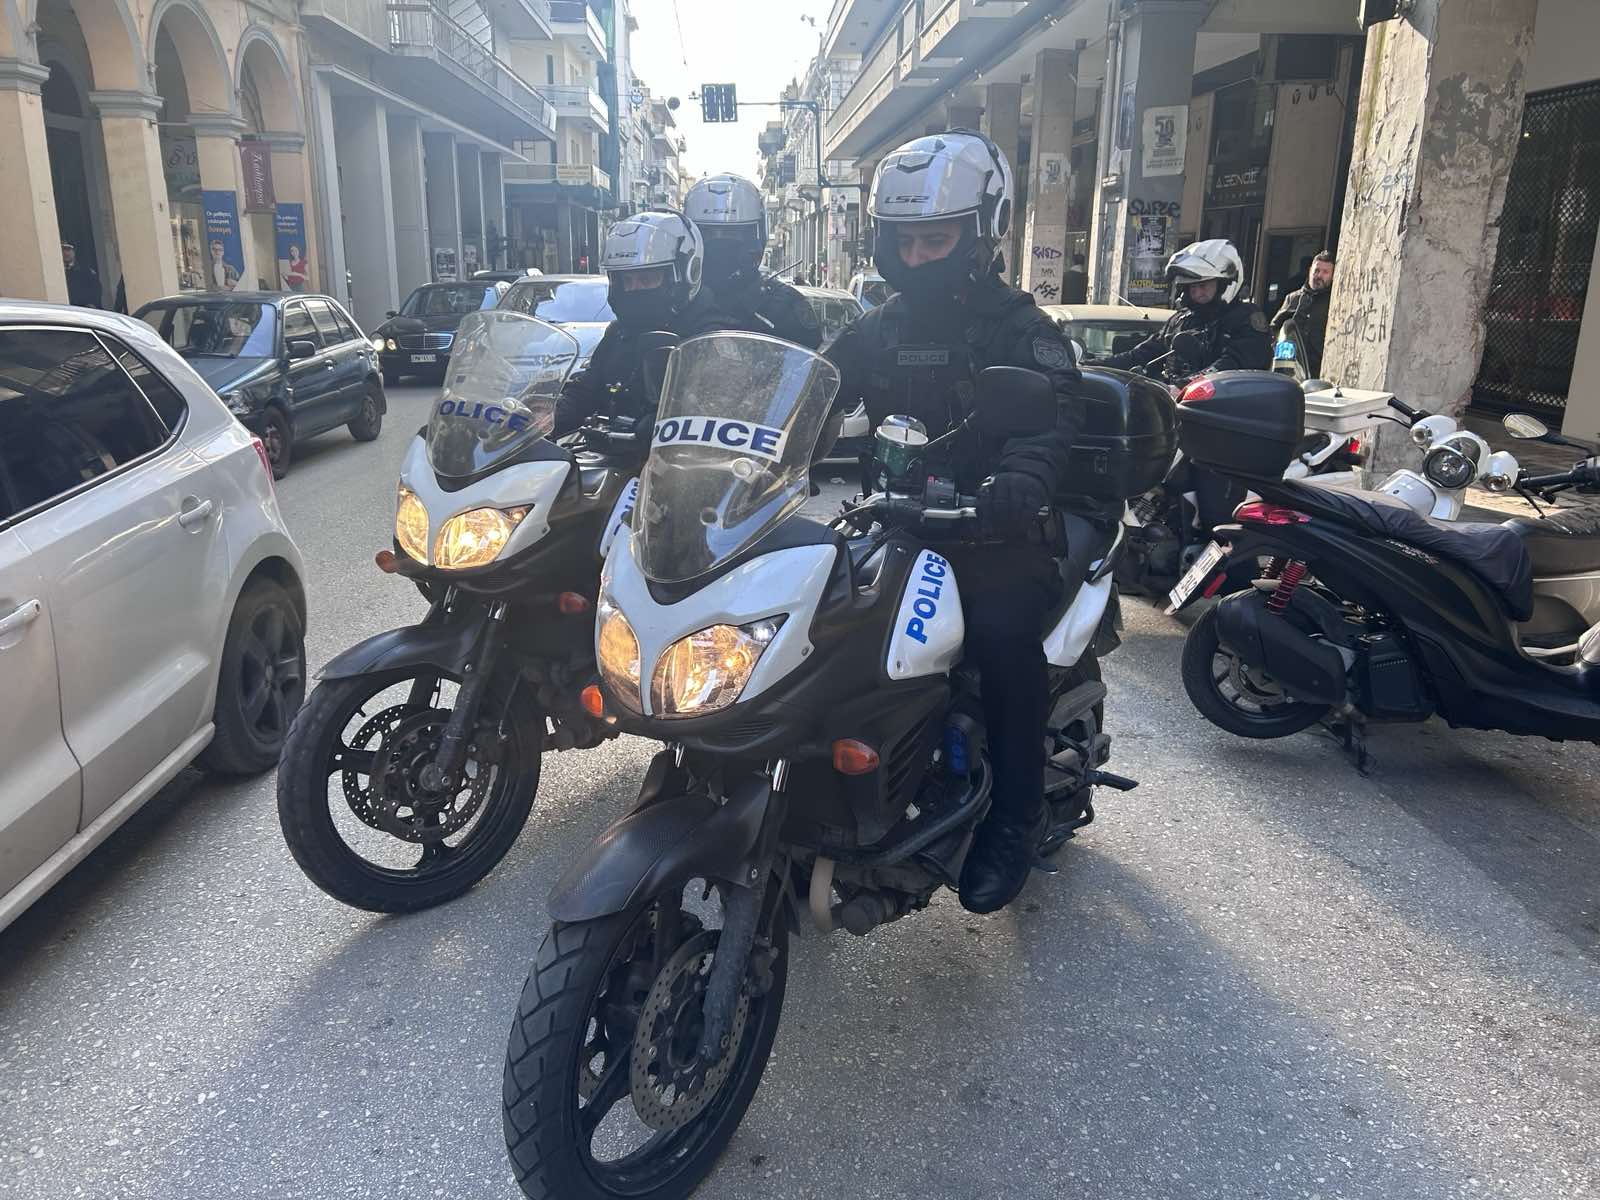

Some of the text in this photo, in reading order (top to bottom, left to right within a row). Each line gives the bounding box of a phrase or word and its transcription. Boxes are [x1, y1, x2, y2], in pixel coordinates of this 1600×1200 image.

[899, 353, 945, 363] POLICE
[440, 400, 529, 432] OLICE
[905, 553, 947, 645] POLICE
